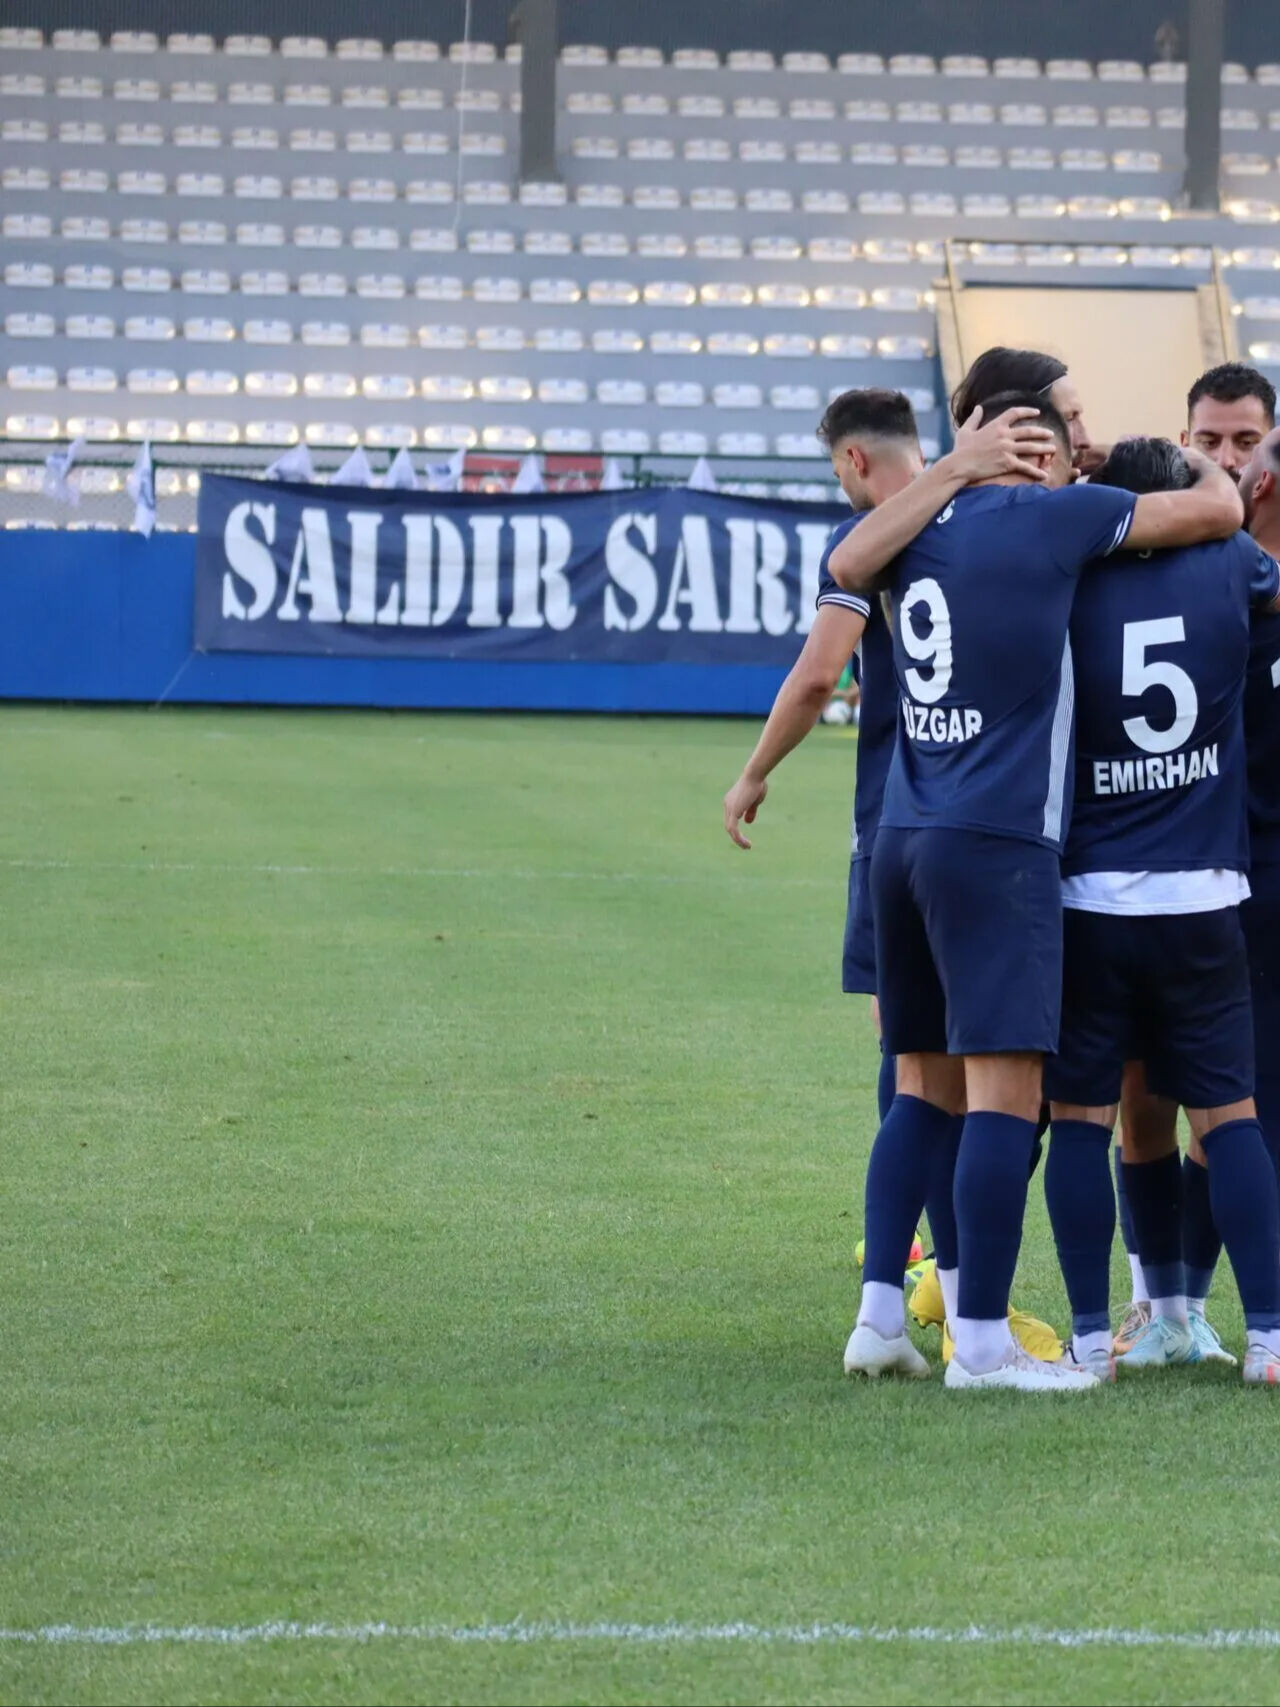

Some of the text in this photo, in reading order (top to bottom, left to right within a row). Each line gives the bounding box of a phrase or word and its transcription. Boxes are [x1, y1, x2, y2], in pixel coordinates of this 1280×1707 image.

[222, 502, 836, 635] SALDIR SARI
[900, 577, 953, 704] 9
[1121, 615, 1198, 754] 5
[901, 696, 983, 743] ÜZGAR
